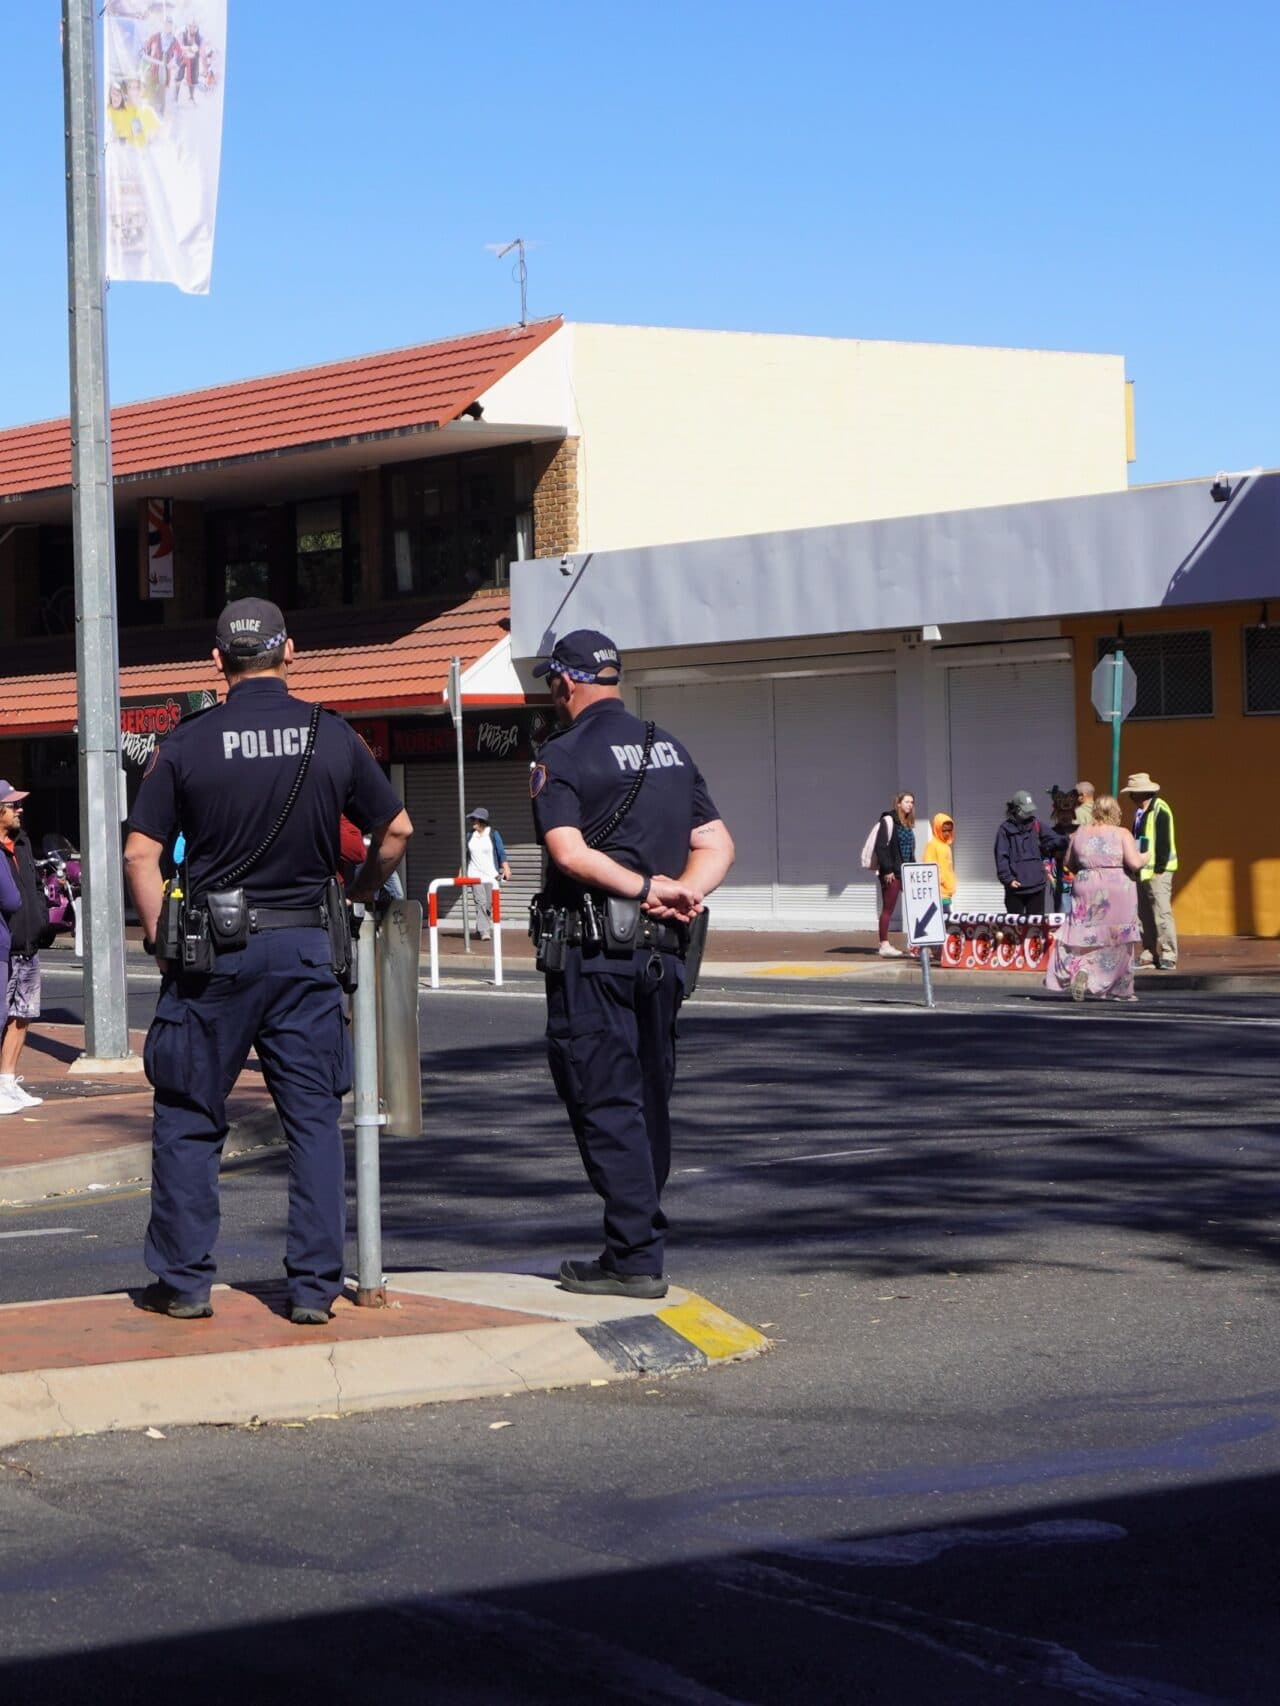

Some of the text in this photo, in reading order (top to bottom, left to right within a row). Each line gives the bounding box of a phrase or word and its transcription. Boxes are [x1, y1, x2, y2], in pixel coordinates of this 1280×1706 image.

[229, 618, 262, 634] POLICE
[909, 870, 933, 884] KEEP
[911, 887, 933, 900] LEFT
